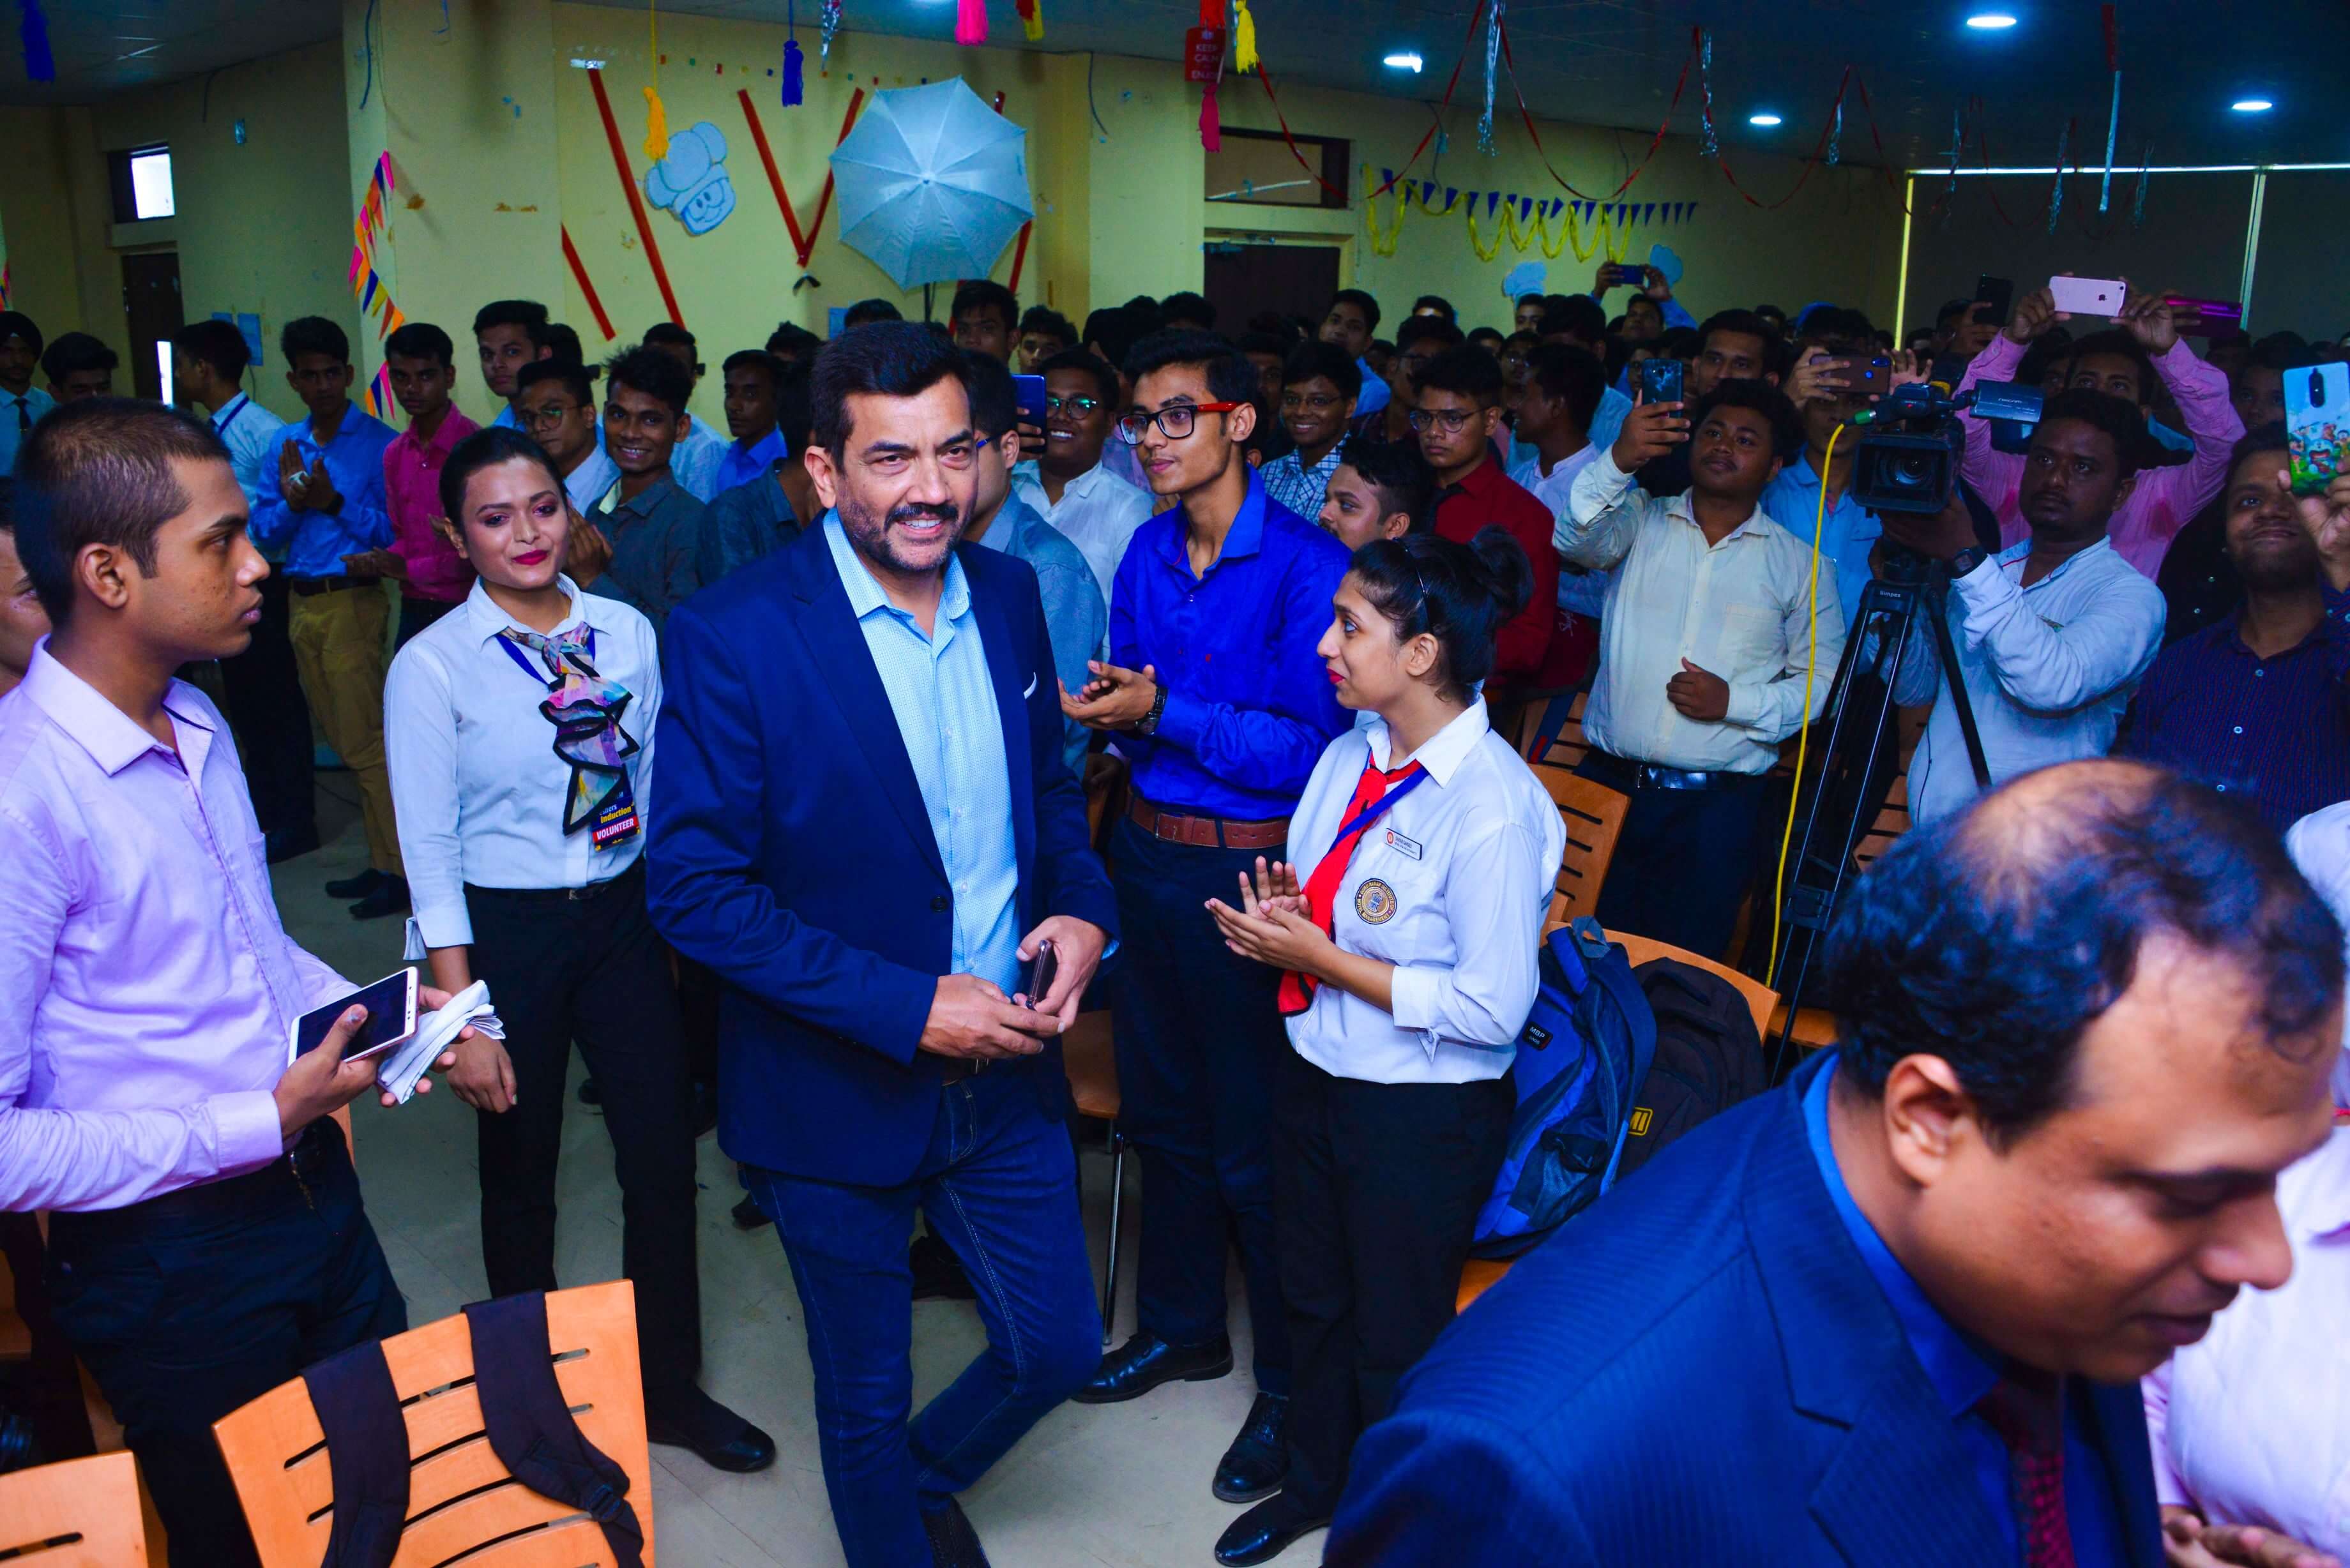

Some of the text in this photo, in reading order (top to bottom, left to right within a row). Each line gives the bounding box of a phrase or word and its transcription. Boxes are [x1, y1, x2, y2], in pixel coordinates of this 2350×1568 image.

[596, 818, 634, 840] VOLUNTEER
[1381, 884, 1395, 905] INSTITUTE
[1362, 912, 1390, 923] MANAGEMENT
[1529, 1026, 1545, 1037] MBP
